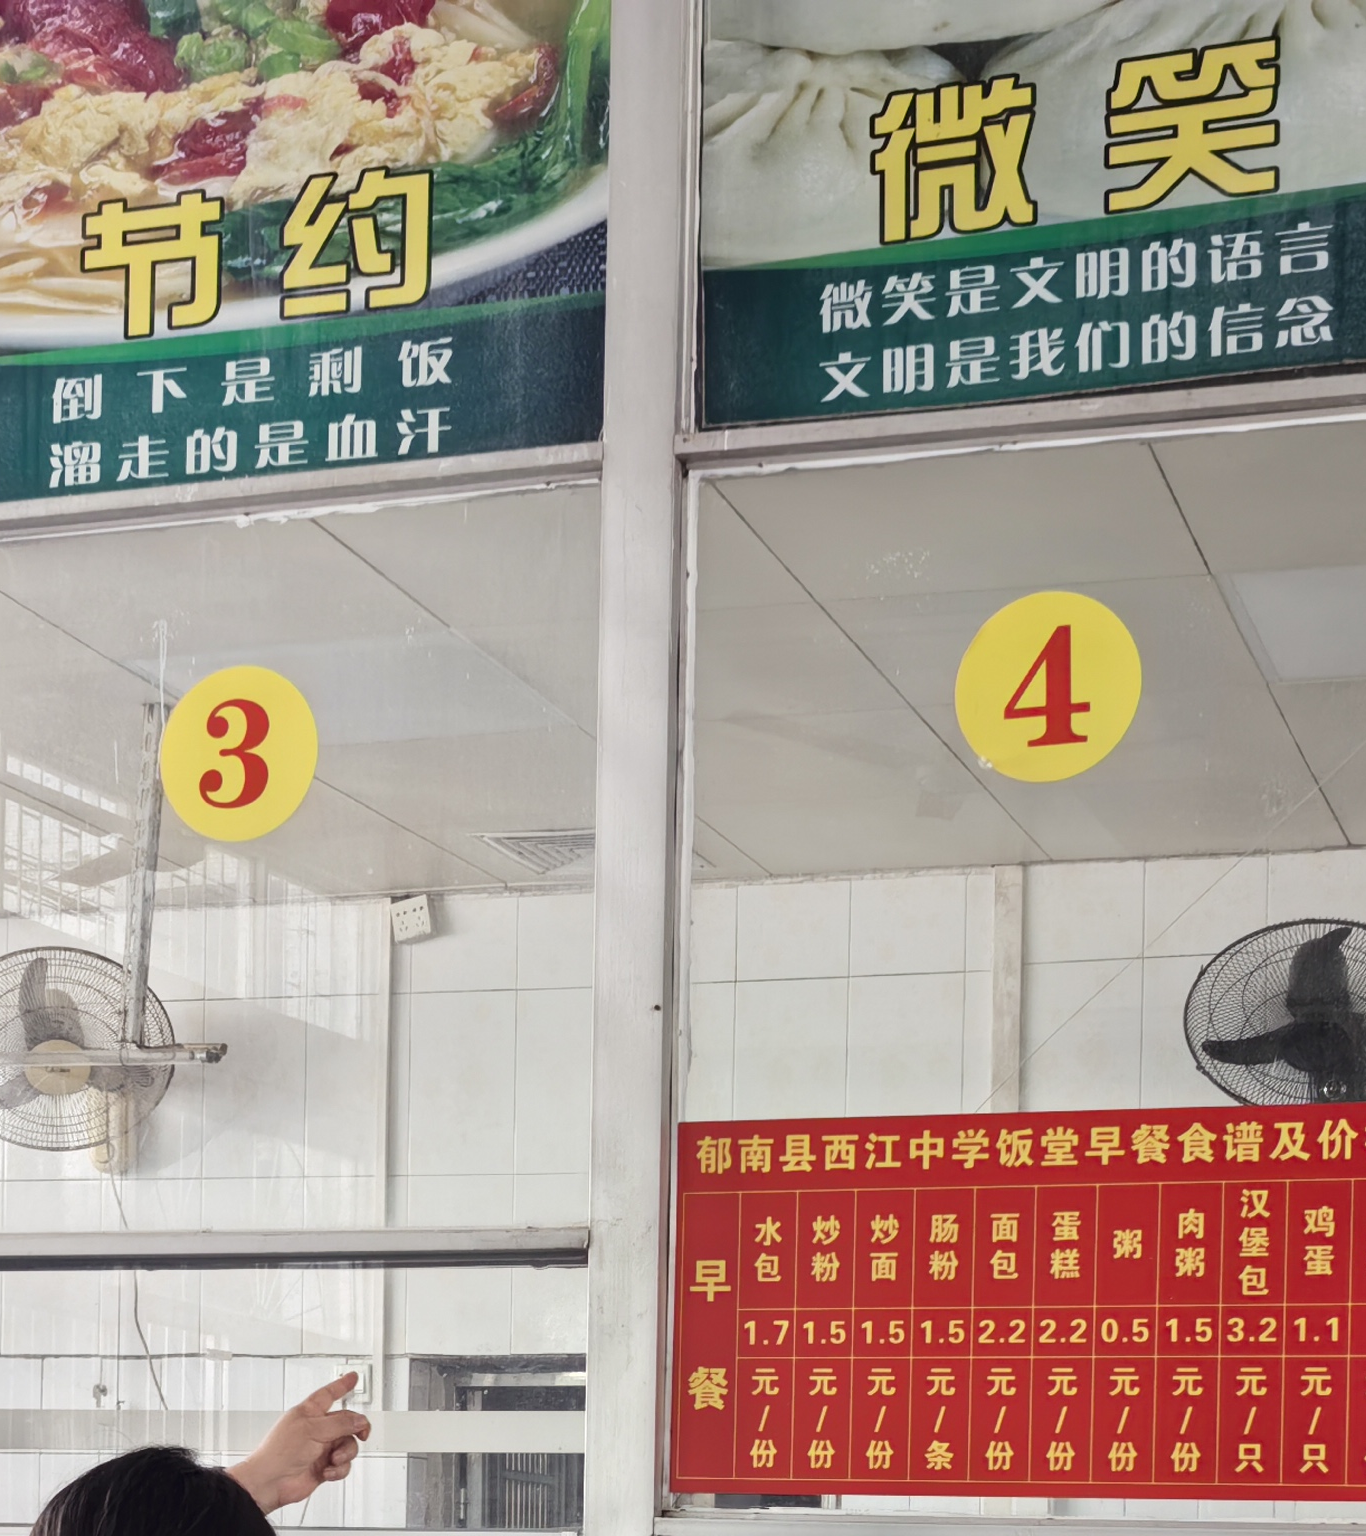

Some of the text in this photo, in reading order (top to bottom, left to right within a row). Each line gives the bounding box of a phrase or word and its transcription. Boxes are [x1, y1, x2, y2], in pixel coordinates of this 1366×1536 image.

[870, 36, 1279, 245] 微笑
[81, 166, 434, 339] 节约
[819, 222, 1334, 333] 微笑是文明的语言
[52, 337, 453, 424] 倒下是剩饭
[819, 295, 1334, 402] 文明是我们的信念
[49, 407, 451, 488] 溜走的是血汗
[1004, 626, 1090, 747] 4
[200, 699, 269, 808] 3
[754, 1216, 783, 1282] 水包
[810, 1215, 841, 1282] 炒粉
[870, 1214, 900, 1282] 炒面
[929, 1214, 959, 1281] 肠粉
[989, 1213, 1020, 1280] 面包
[1049, 1211, 1082, 1280] 蛋糕
[1112, 1228, 1143, 1260] 粥
[1175, 1208, 1205, 1278] 肉粥
[1238, 1188, 1271, 1296] 汉堡包
[1303, 1205, 1336, 1276] 鸡蛋
[744, 1319, 790, 1346] 1.7
[802, 1320, 847, 1345] 1.5
[861, 1320, 905, 1345] 1.5
[920, 1319, 966, 1344] 1.5
[978, 1318, 1026, 1344] 2.2
[1038, 1318, 1088, 1344] 2.2
[1100, 1318, 1150, 1343] 0.5
[1165, 1317, 1213, 1343] 1.5
[1226, 1317, 1278, 1343] 3.2
[1293, 1317, 1339, 1342] 1.1
